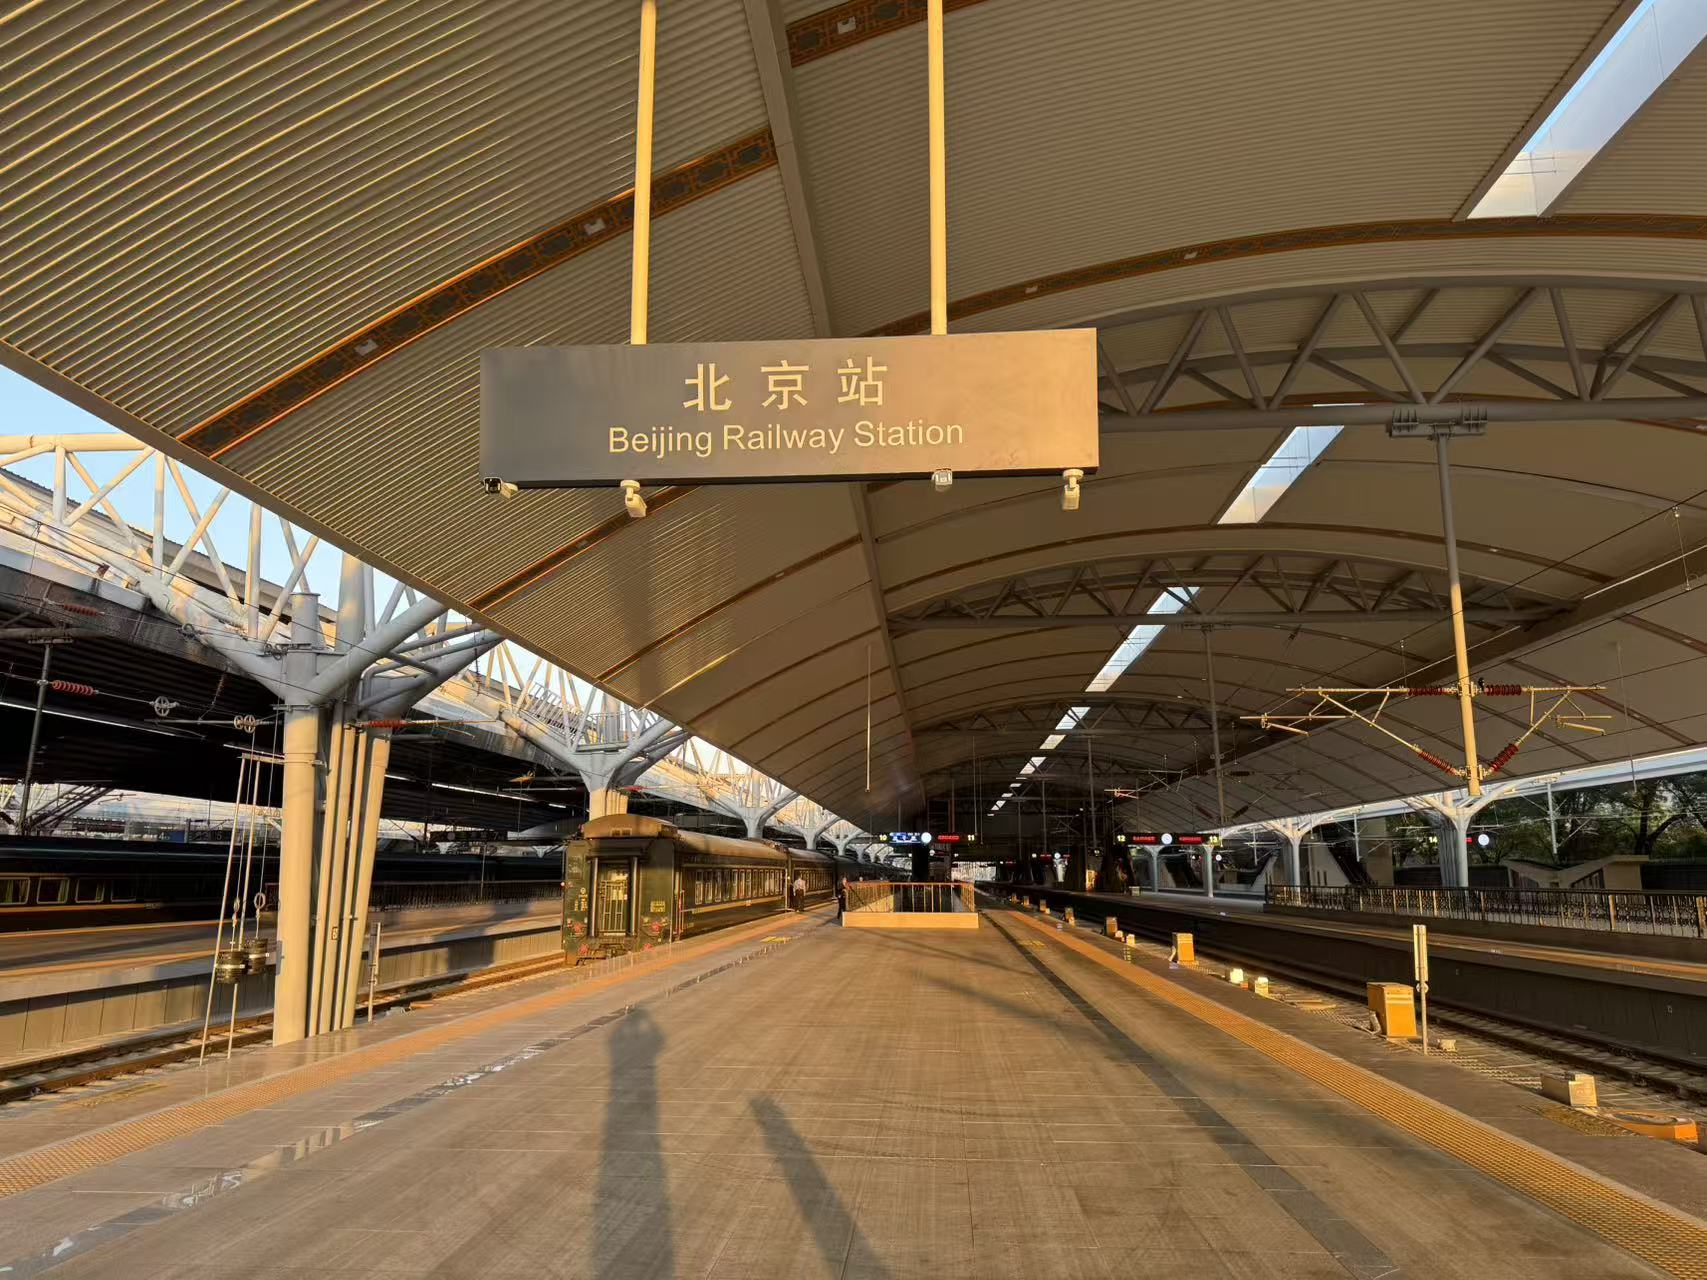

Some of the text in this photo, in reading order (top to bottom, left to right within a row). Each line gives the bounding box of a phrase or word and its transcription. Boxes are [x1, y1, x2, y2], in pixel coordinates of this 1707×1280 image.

[683, 356, 888, 411] 北京站
[608, 419, 964, 459] Beijing Railway Station
